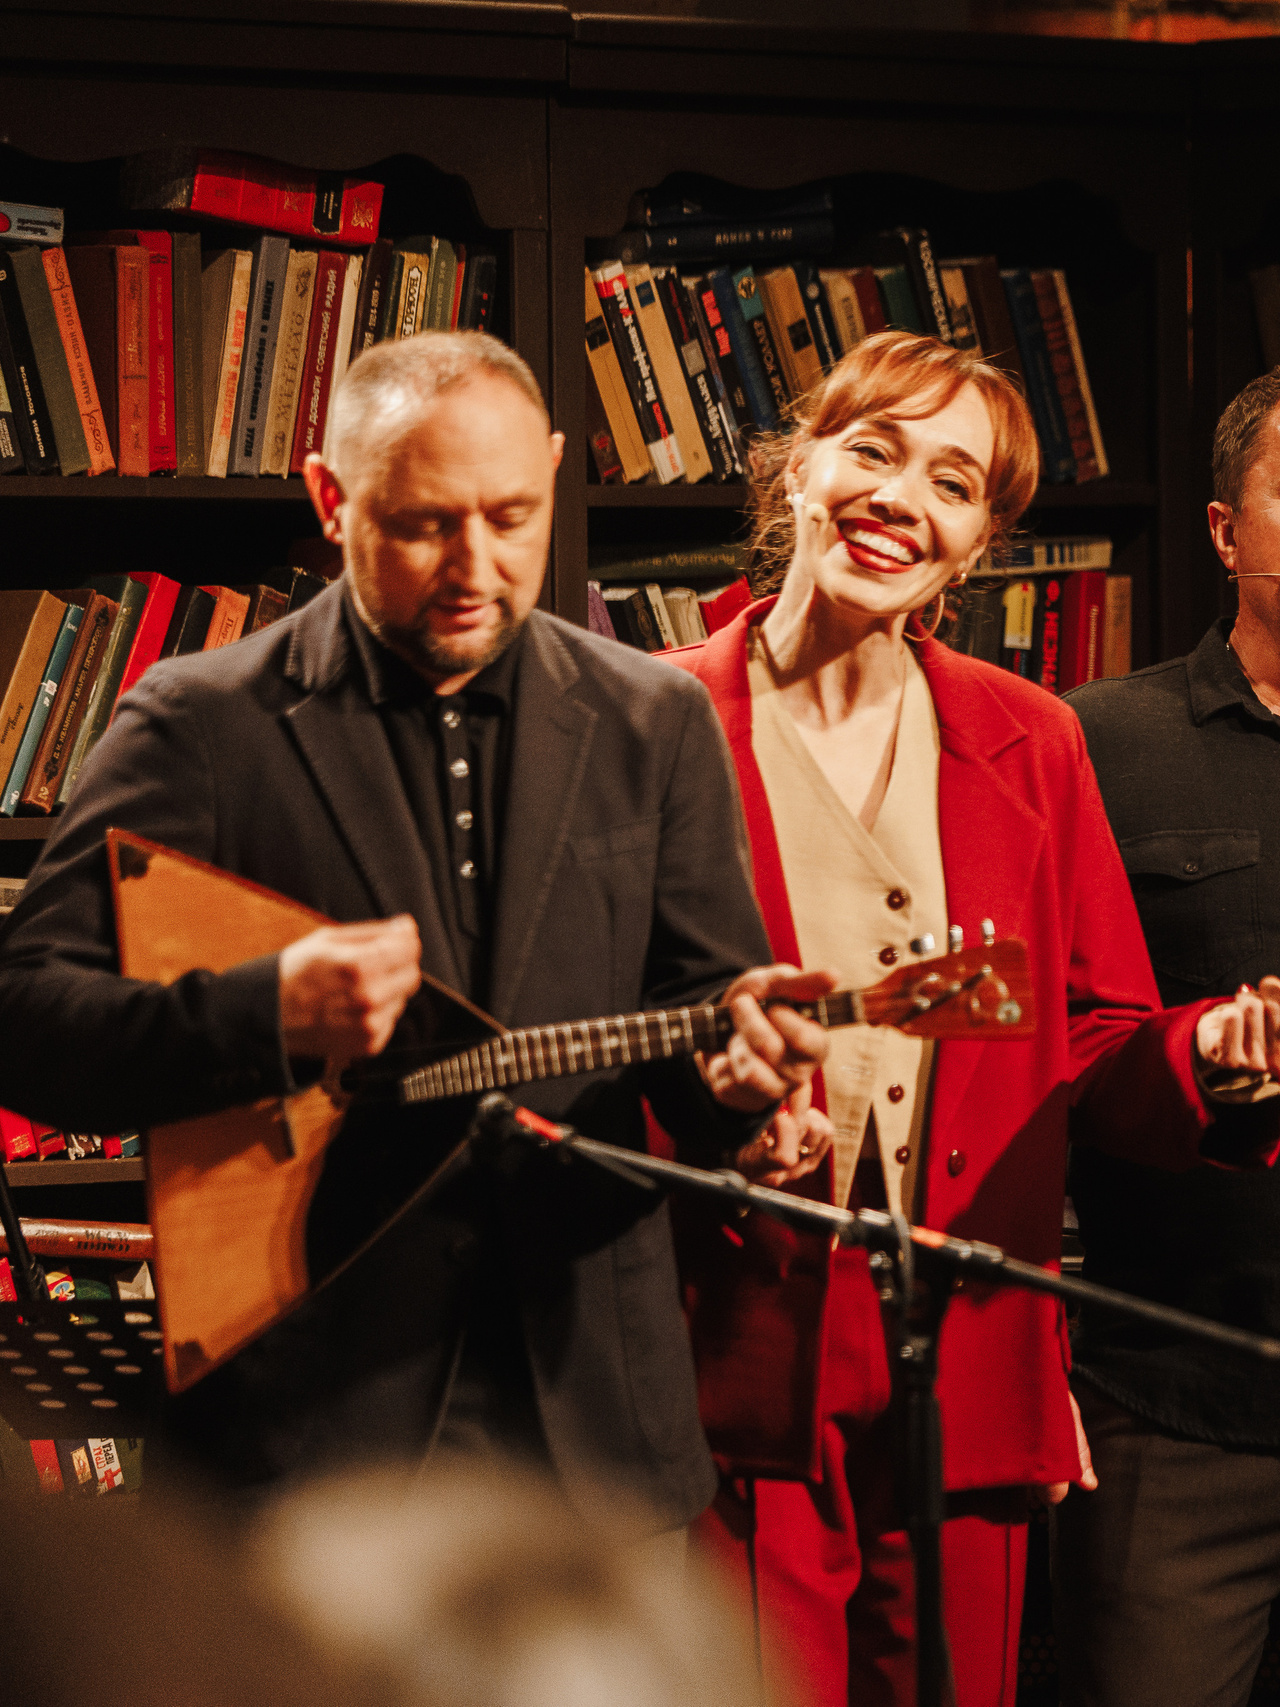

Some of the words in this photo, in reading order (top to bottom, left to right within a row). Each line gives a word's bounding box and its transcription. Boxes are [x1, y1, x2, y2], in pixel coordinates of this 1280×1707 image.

[260, 279, 274, 321] ХИМИЯ
[322, 267, 338, 308] РАДИЙ
[313, 310, 332, 373] СОВЕТСКИЙ
[18, 365, 36, 415] ВСЕВОЛОД
[31, 418, 46, 458] ИВАНОВ
[37, 785, 50, 801] 2
[92, 1446, 106, 1470] СТРАХ
[102, 1441, 115, 1465] ПЕРЕД
